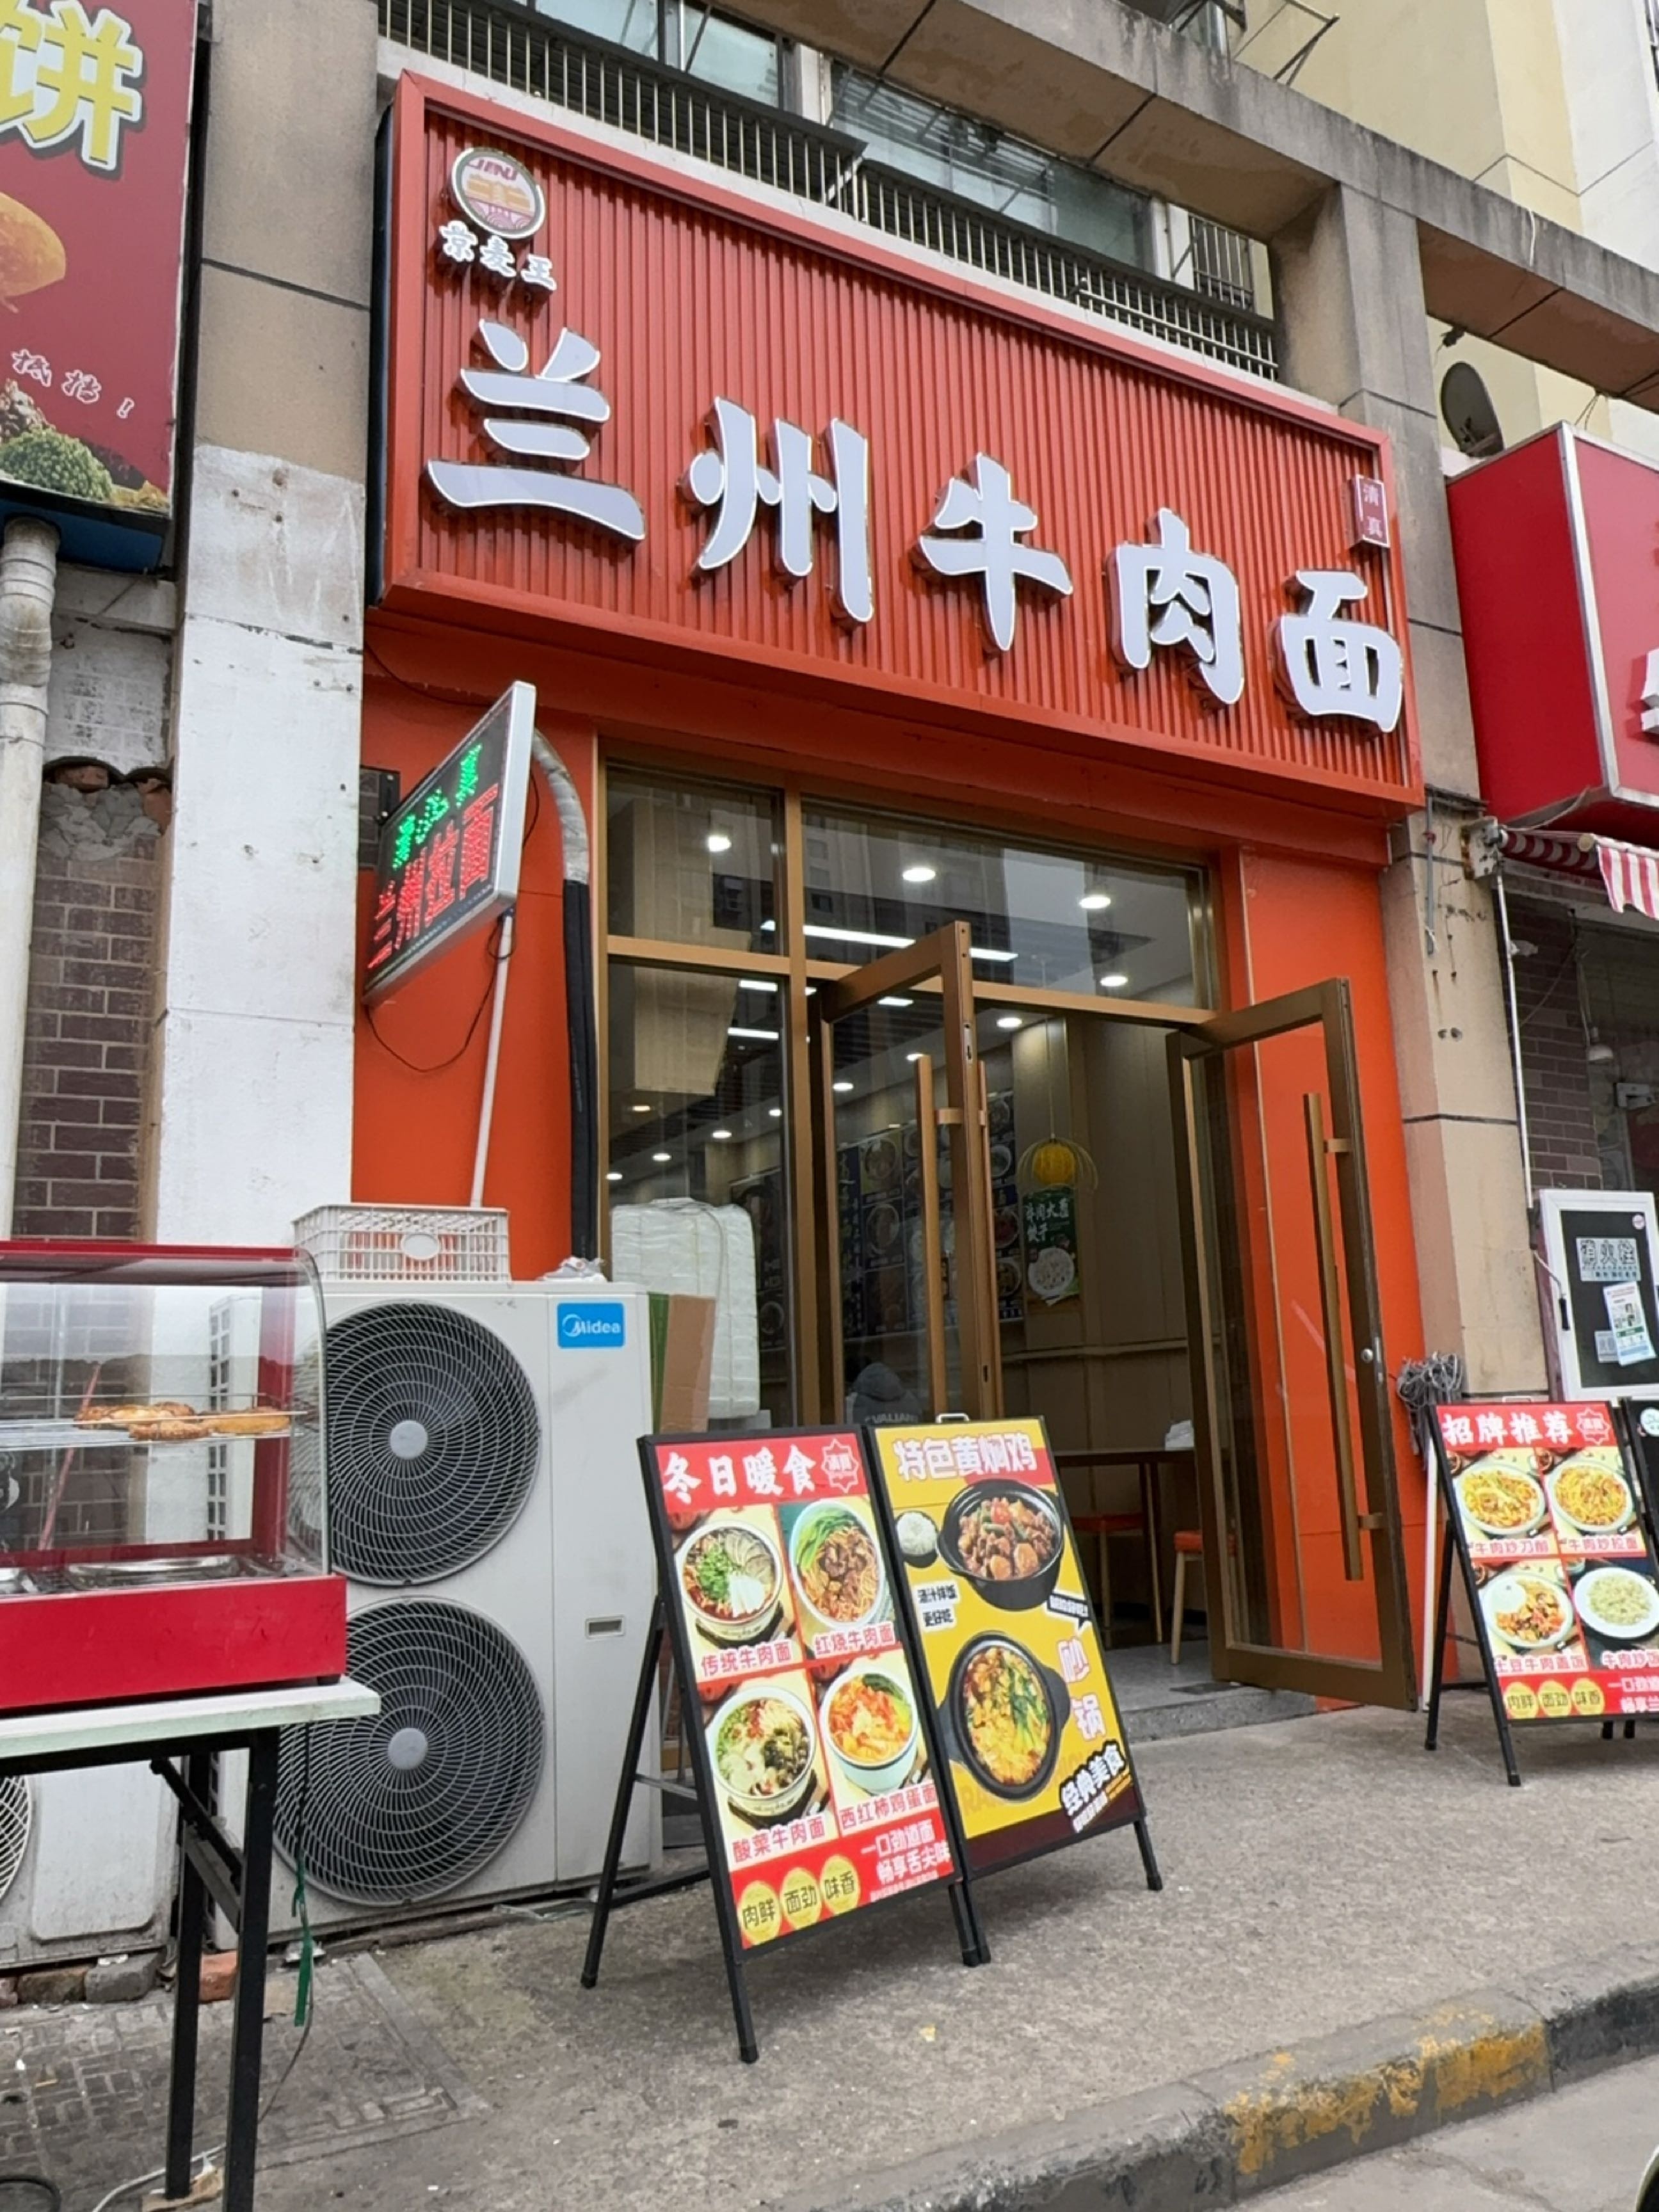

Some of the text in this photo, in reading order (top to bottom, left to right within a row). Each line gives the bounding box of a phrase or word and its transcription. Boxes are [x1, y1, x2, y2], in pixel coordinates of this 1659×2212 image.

[427, 319, 1404, 733] 兰州牛肉面
[368, 783, 499, 969] 兰州拉面
[574, 1319, 621, 1335] Midea
[1442, 1411, 1573, 1446] 招牌推荐
[663, 1444, 817, 1504] 冬日暖食
[894, 1432, 1038, 1481] 特色黄焖鸡
[814, 1623, 896, 1656] 红烧牛肉面
[701, 1640, 792, 1677] 传统牛肉面
[839, 1783, 937, 1828] 西红柿鸡蛋面
[732, 1816, 826, 1863] 酸菜牛肉面
[783, 1886, 818, 1914] 面劲
[824, 1871, 856, 1898] 味香
[742, 1898, 776, 1930] 肉鲜
